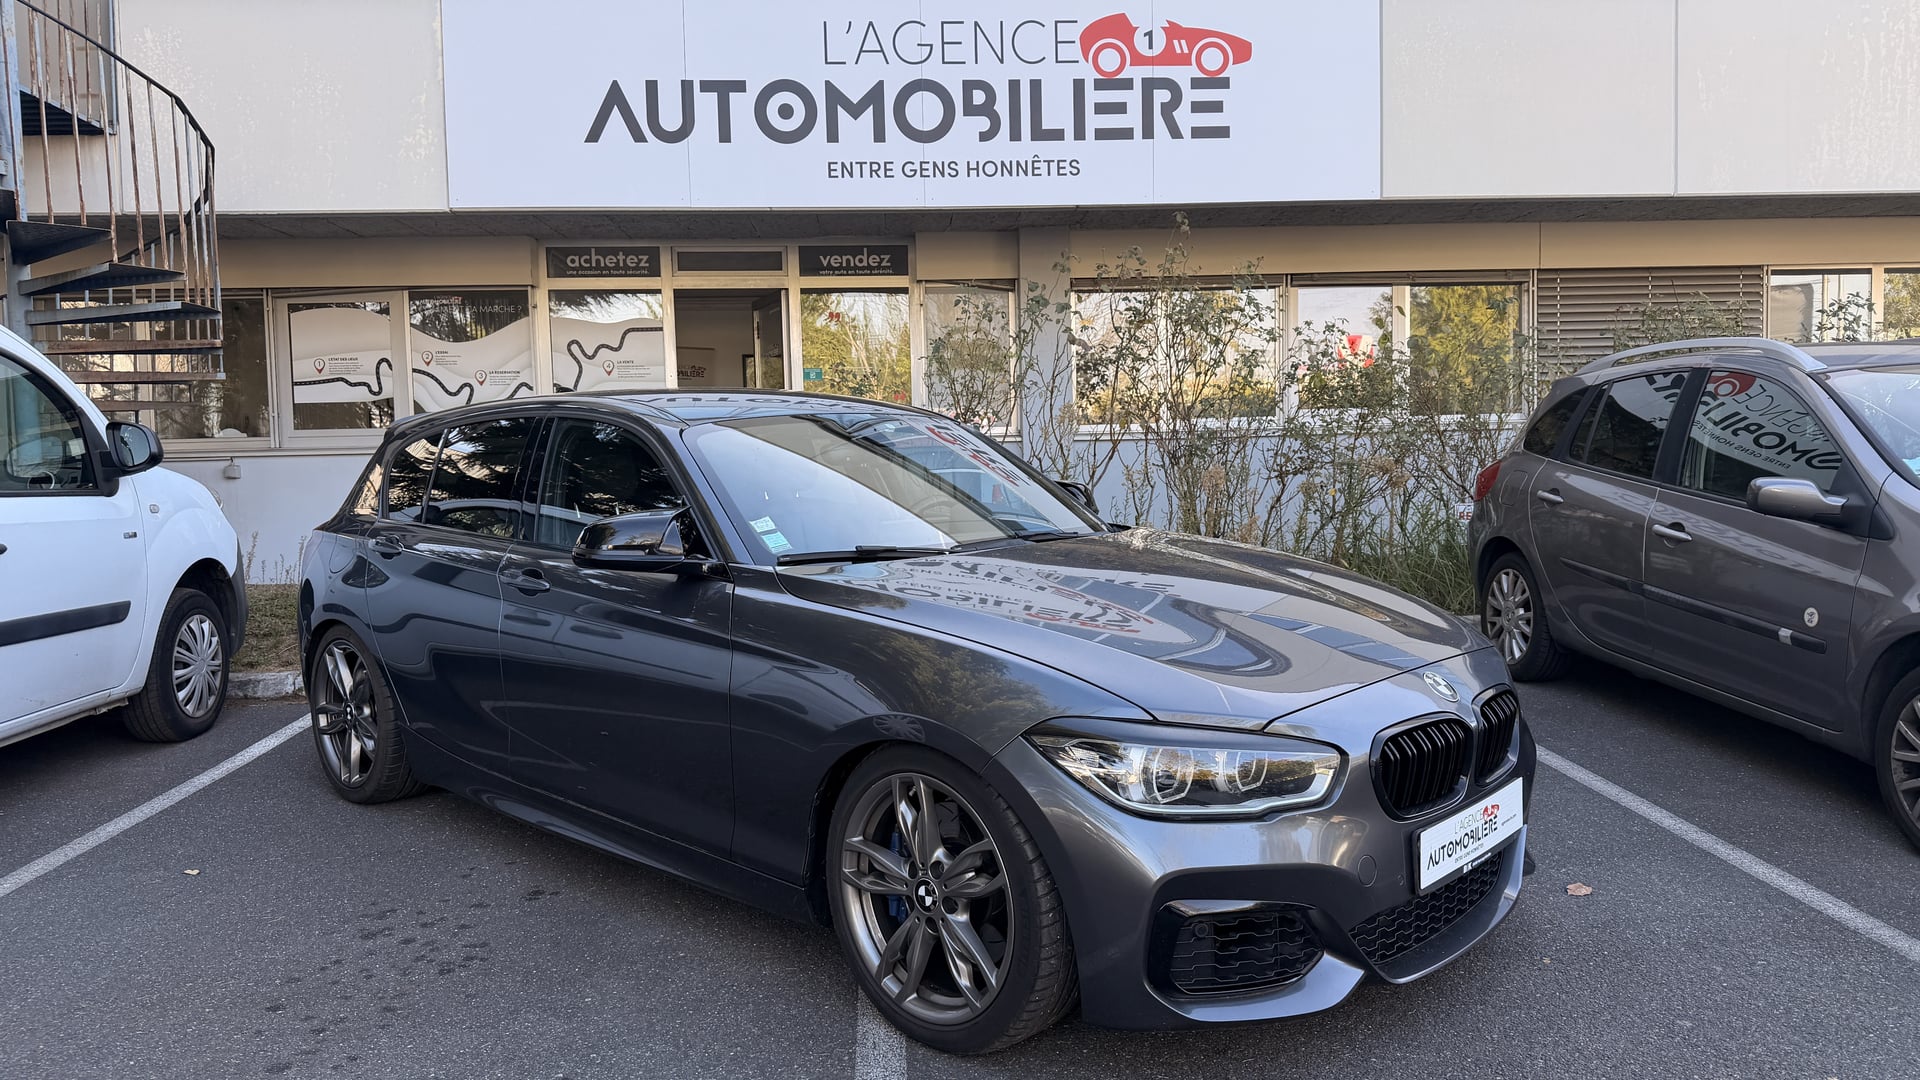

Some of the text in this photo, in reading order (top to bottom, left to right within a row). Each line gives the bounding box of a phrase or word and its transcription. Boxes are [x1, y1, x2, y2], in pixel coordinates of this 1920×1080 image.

[823, 20, 1080, 65] L'AGENCE
[1143, 30, 1154, 50] 1
[827, 154, 1081, 179] ENTRE GENS HONNÊTES
[566, 248, 650, 267] achetez
[819, 247, 891, 267] vendez
